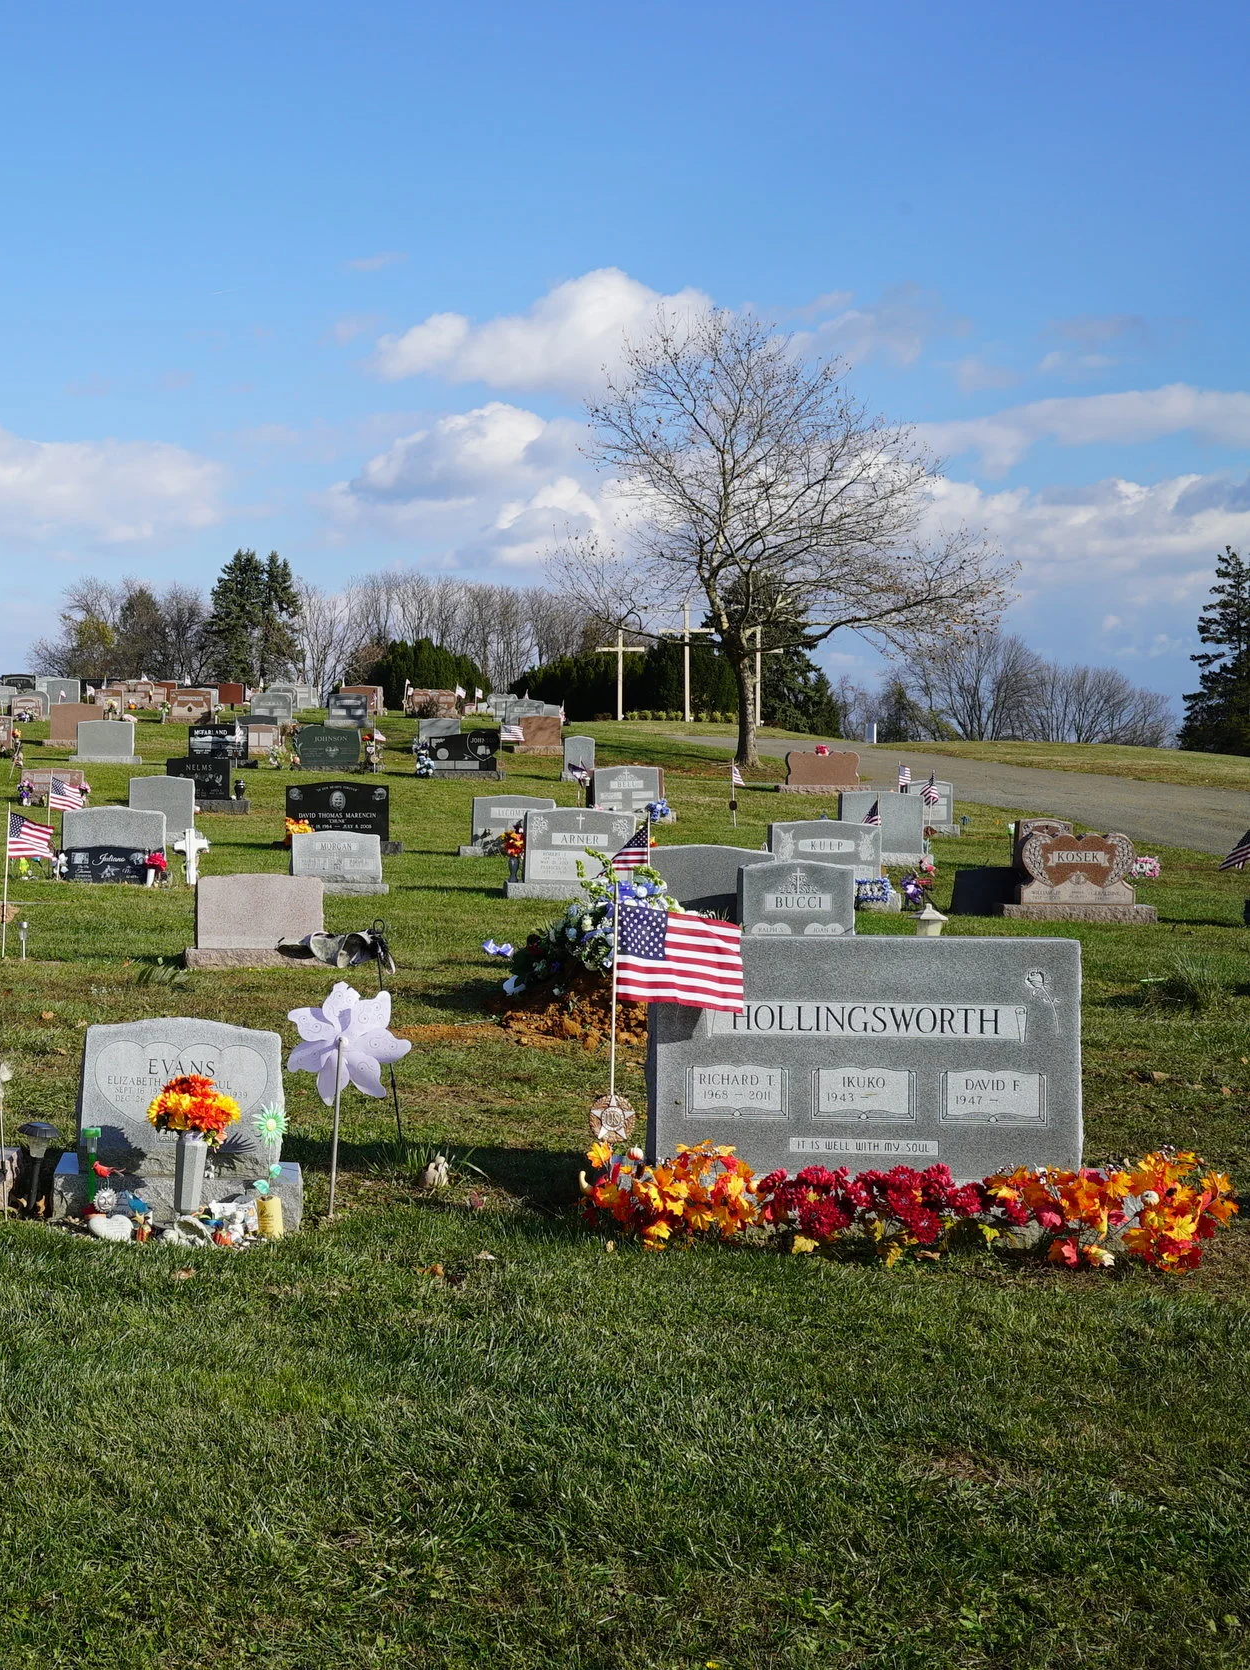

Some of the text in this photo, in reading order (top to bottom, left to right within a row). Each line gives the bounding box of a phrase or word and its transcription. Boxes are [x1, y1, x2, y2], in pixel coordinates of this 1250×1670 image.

[314, 735, 348, 743] JOHNSON
[560, 834, 599, 845] ARNER
[810, 840, 844, 851] KULP
[320, 842, 352, 851] MORGAN
[91, 852, 126, 866] Juliano
[1057, 852, 1100, 862] KOSEK
[775, 896, 822, 909] BUCCI
[731, 1004, 1000, 1035] HOLLINGSWORTH
[148, 1058, 216, 1078] EVANS
[107, 1076, 161, 1087] ELIZABETH
[211, 1080, 232, 1090] AUL
[698, 1072, 760, 1086] RICHARD
[841, 1076, 886, 1090] IKUKO
[964, 1078, 1006, 1092] DAVID
[702, 1089, 772, 1102] 1968 2011
[826, 1091, 855, 1103] 1943
[955, 1095, 983, 1106] 1947
[606, 1110, 621, 1126] US
[796, 1139, 808, 1151] IT
[810, 1139, 820, 1151] IS
[824, 1140, 850, 1152] WELL
[855, 1140, 881, 1153] WITH
[905, 1142, 930, 1154] SOUL
